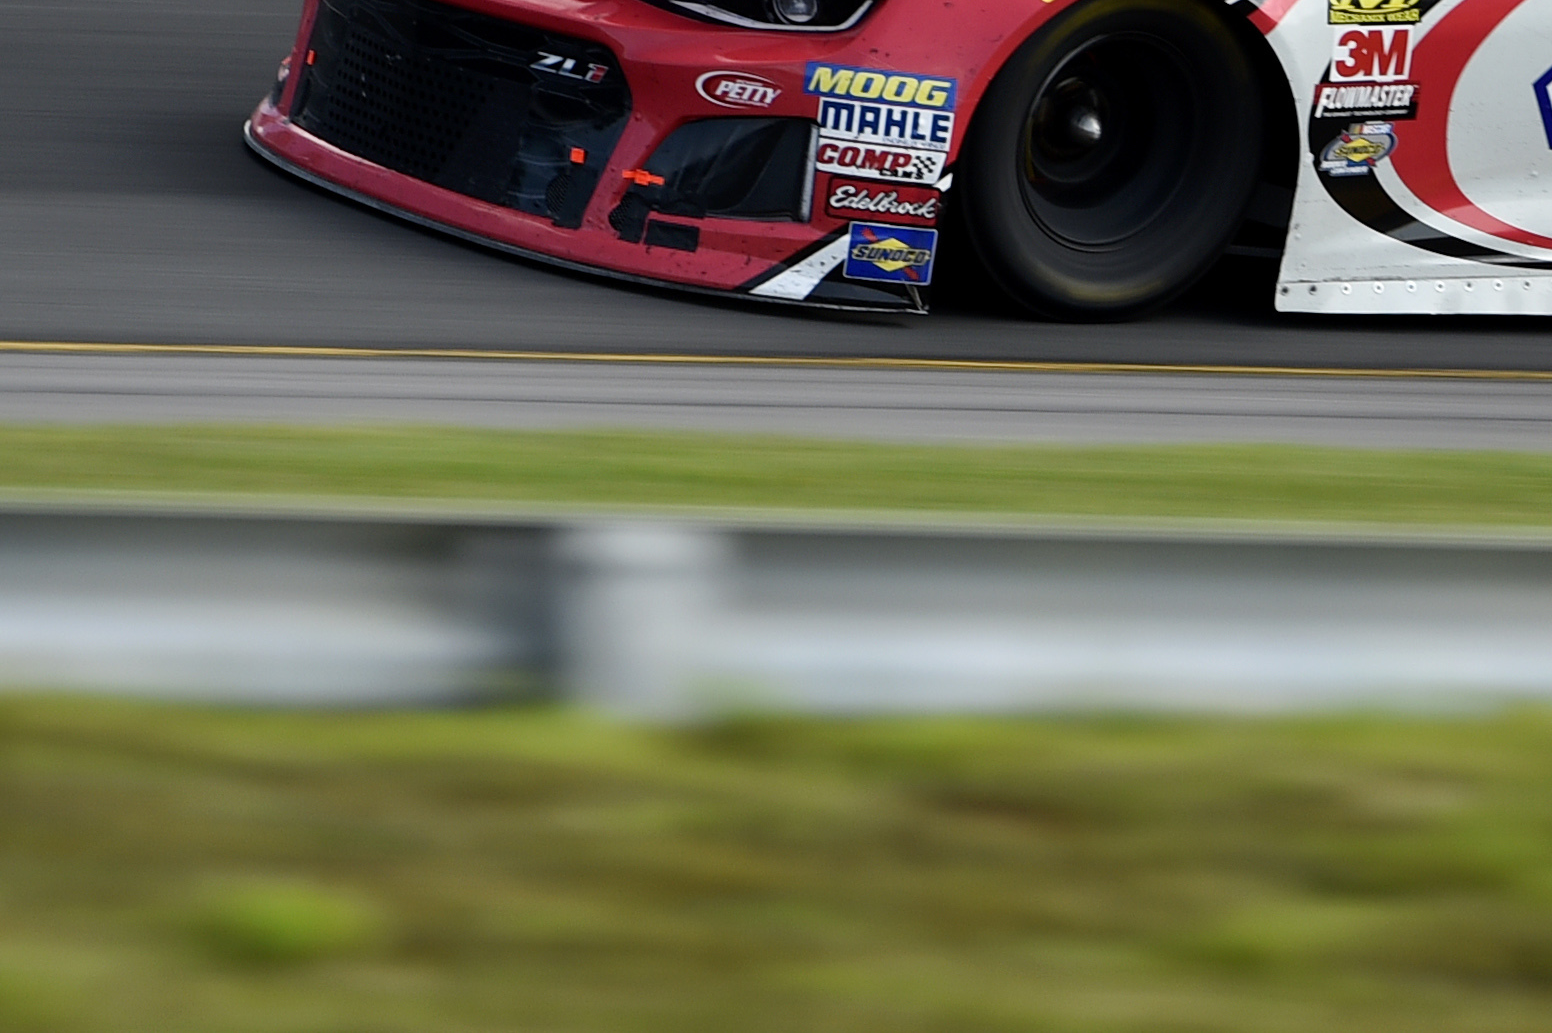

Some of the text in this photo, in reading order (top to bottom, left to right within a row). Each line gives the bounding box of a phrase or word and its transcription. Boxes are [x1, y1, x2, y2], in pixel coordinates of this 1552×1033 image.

[529, 51, 609, 84] ZL1
[1335, 30, 1410, 78] 3M
[714, 80, 782, 104] PETTY
[807, 66, 952, 107] MOOG
[1314, 84, 1418, 118] FLOWMASTER
[820, 100, 951, 143] MAHLE
[817, 143, 912, 172] COMP
[829, 185, 937, 218] Edelbrock
[853, 245, 929, 265] SUNOCO
